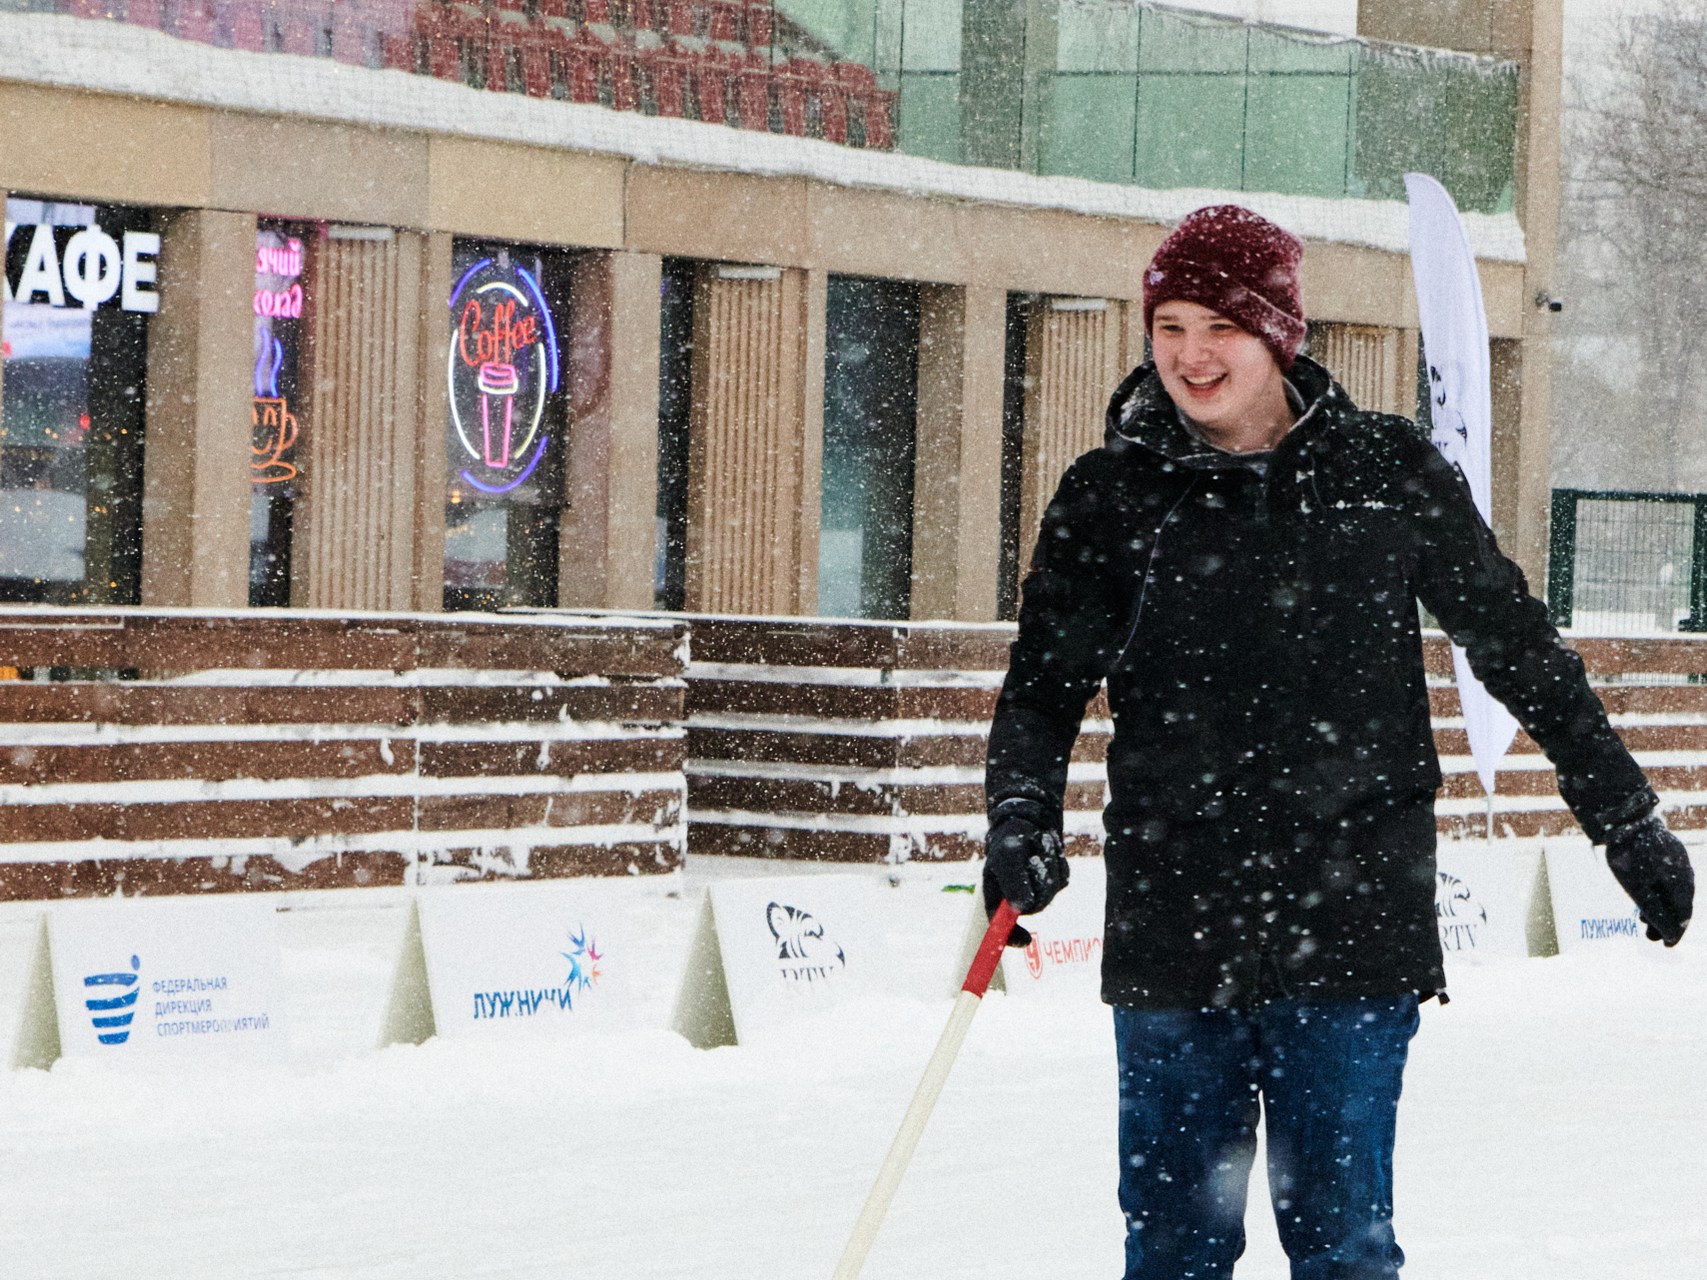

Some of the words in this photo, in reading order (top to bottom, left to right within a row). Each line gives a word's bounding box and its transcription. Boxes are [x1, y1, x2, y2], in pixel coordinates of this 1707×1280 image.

[460, 299, 536, 366] Coffee
[1581, 918, 1638, 939] ЛУЖНИКИ
[152, 976, 228, 996] ФЕДЕРАЛЬНАЯ
[155, 998, 213, 1017] ДИРЕКЦИЯ
[157, 1012, 270, 1037] СПОРТМЕРОПИЯТИЙ
